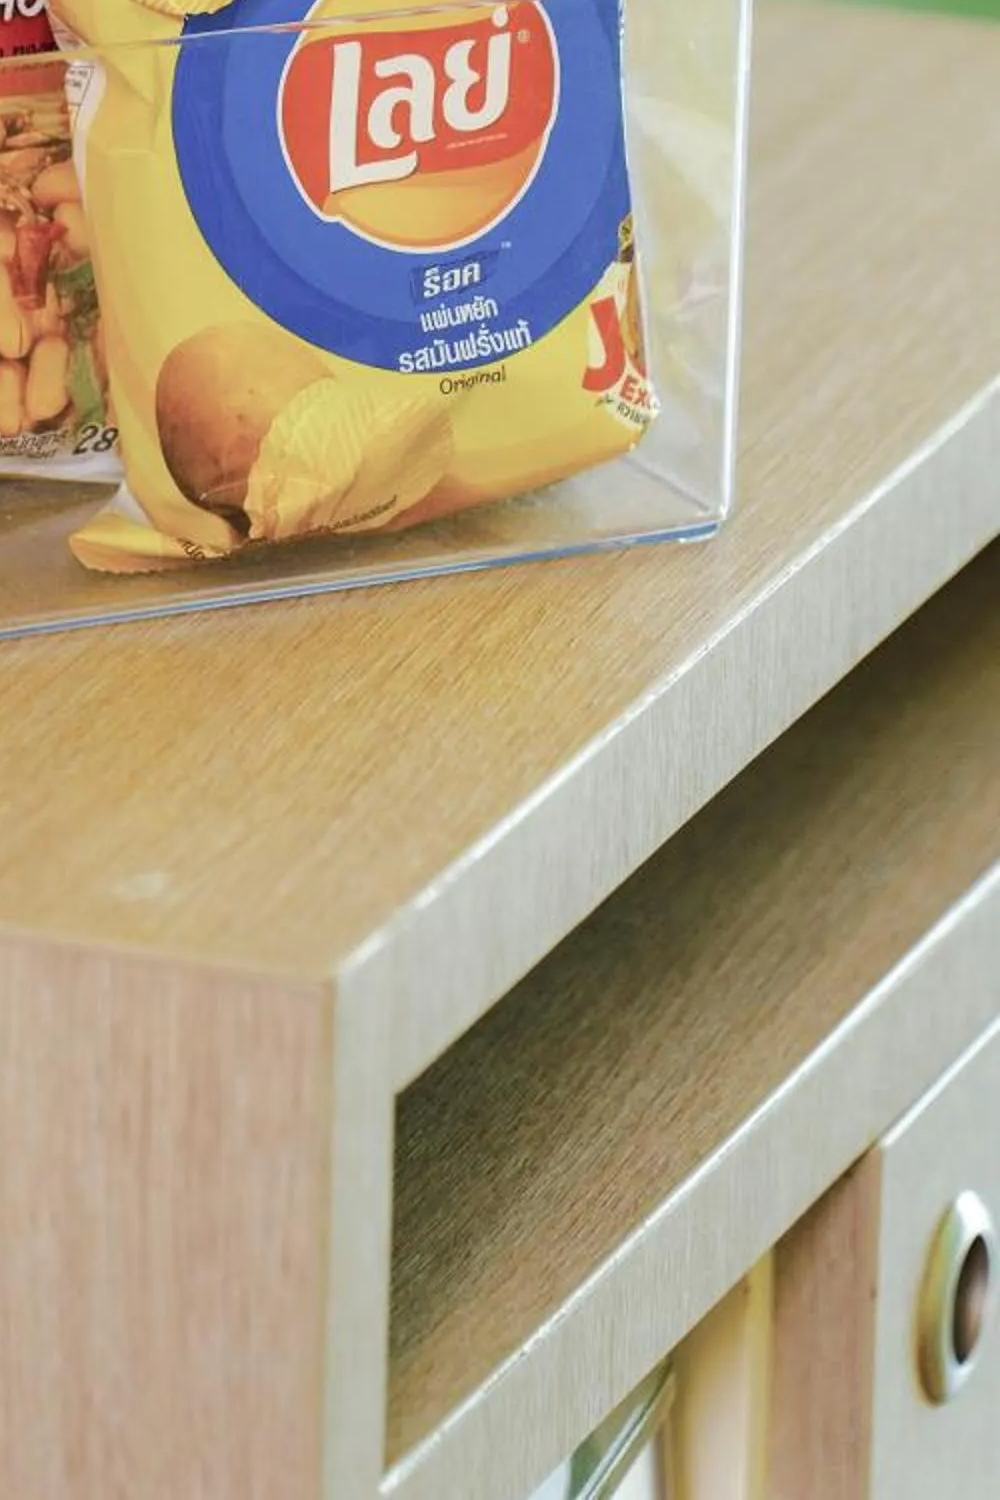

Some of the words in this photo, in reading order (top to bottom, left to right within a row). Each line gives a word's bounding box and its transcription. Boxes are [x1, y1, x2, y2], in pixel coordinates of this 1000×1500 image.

[420, 296, 498, 333] แผ่นหยัก
[439, 364, 507, 395] Original
[73, 425, 118, 455] 28
